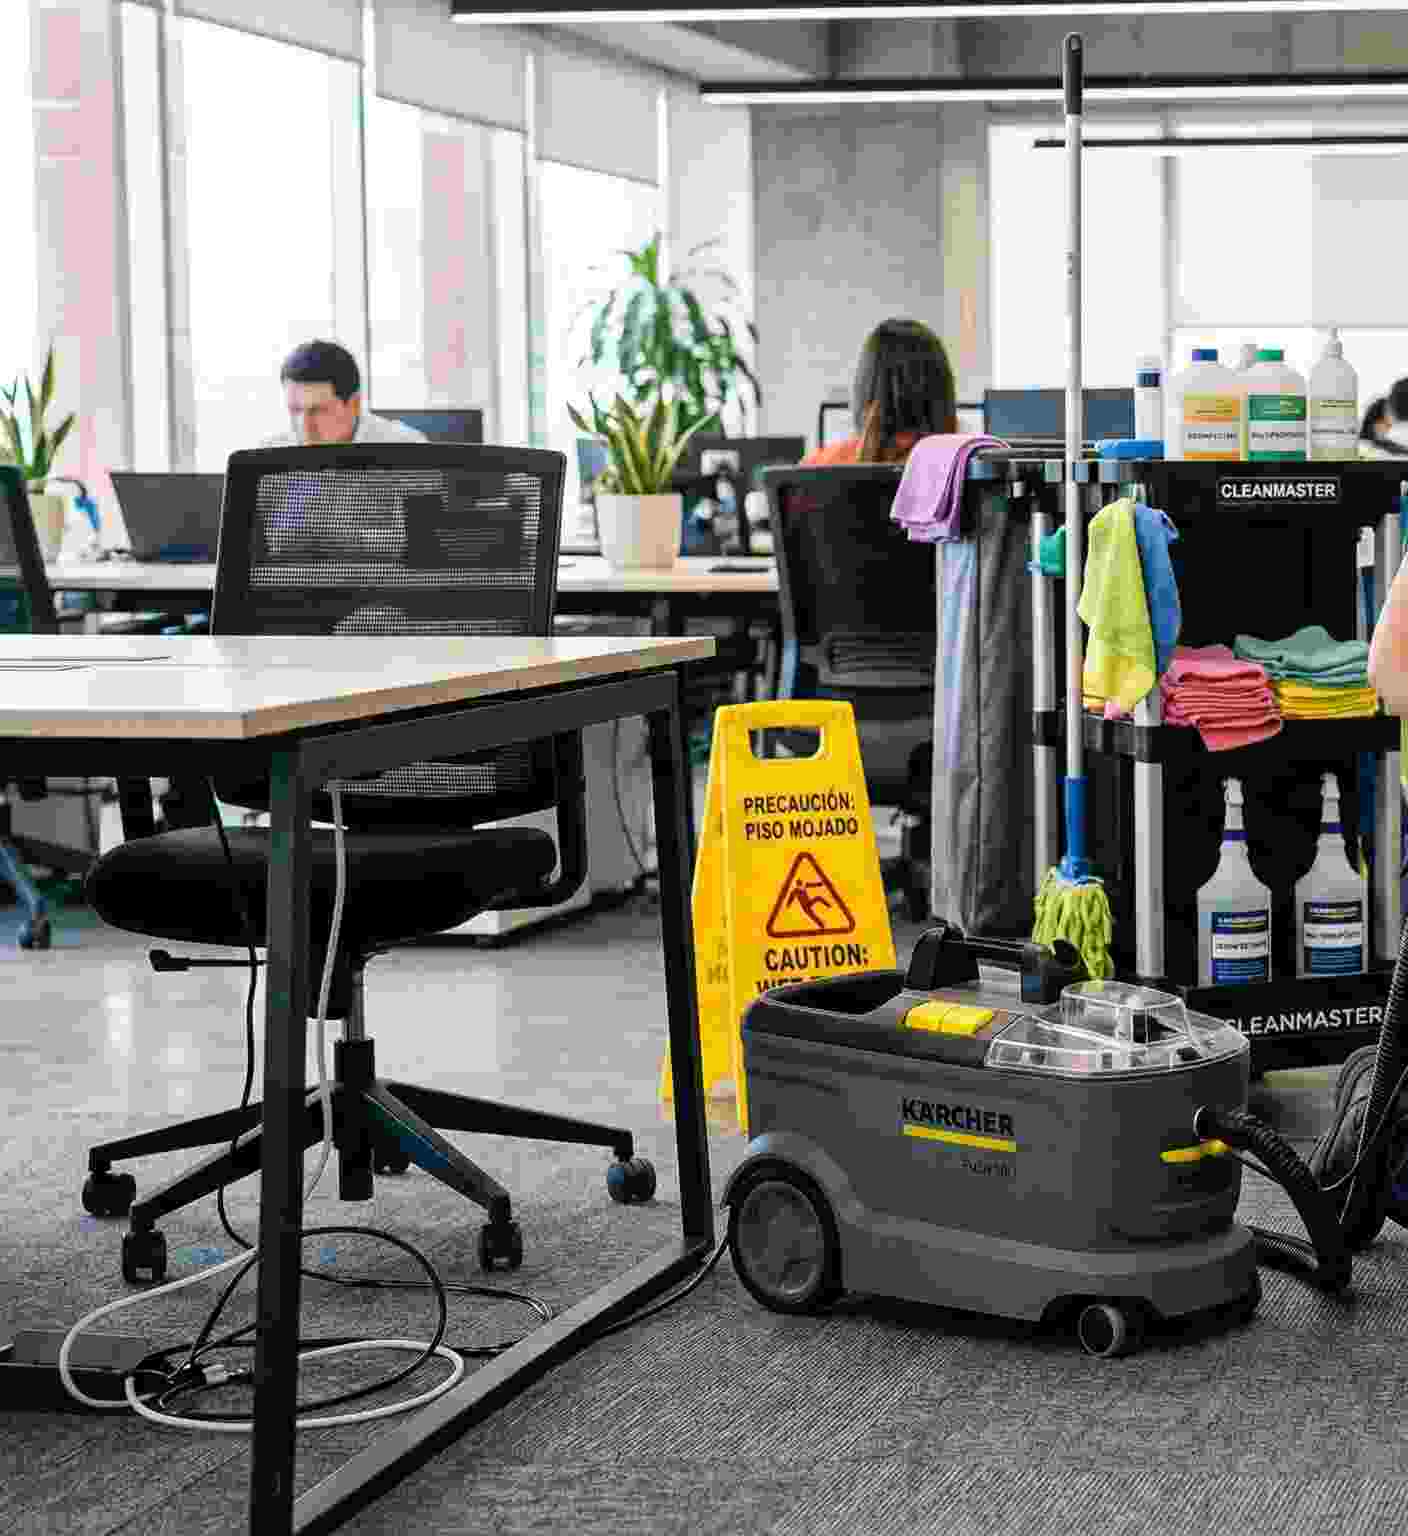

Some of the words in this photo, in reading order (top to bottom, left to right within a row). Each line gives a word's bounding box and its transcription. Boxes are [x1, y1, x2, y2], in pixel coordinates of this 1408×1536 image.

[1220, 483, 1336, 498] CLEANMASTER
[743, 787, 856, 815] PRECAUCIÓN:
[745, 821, 784, 841] PISO
[789, 817, 858, 840] MOJADO
[764, 944, 870, 972] CAUTION:
